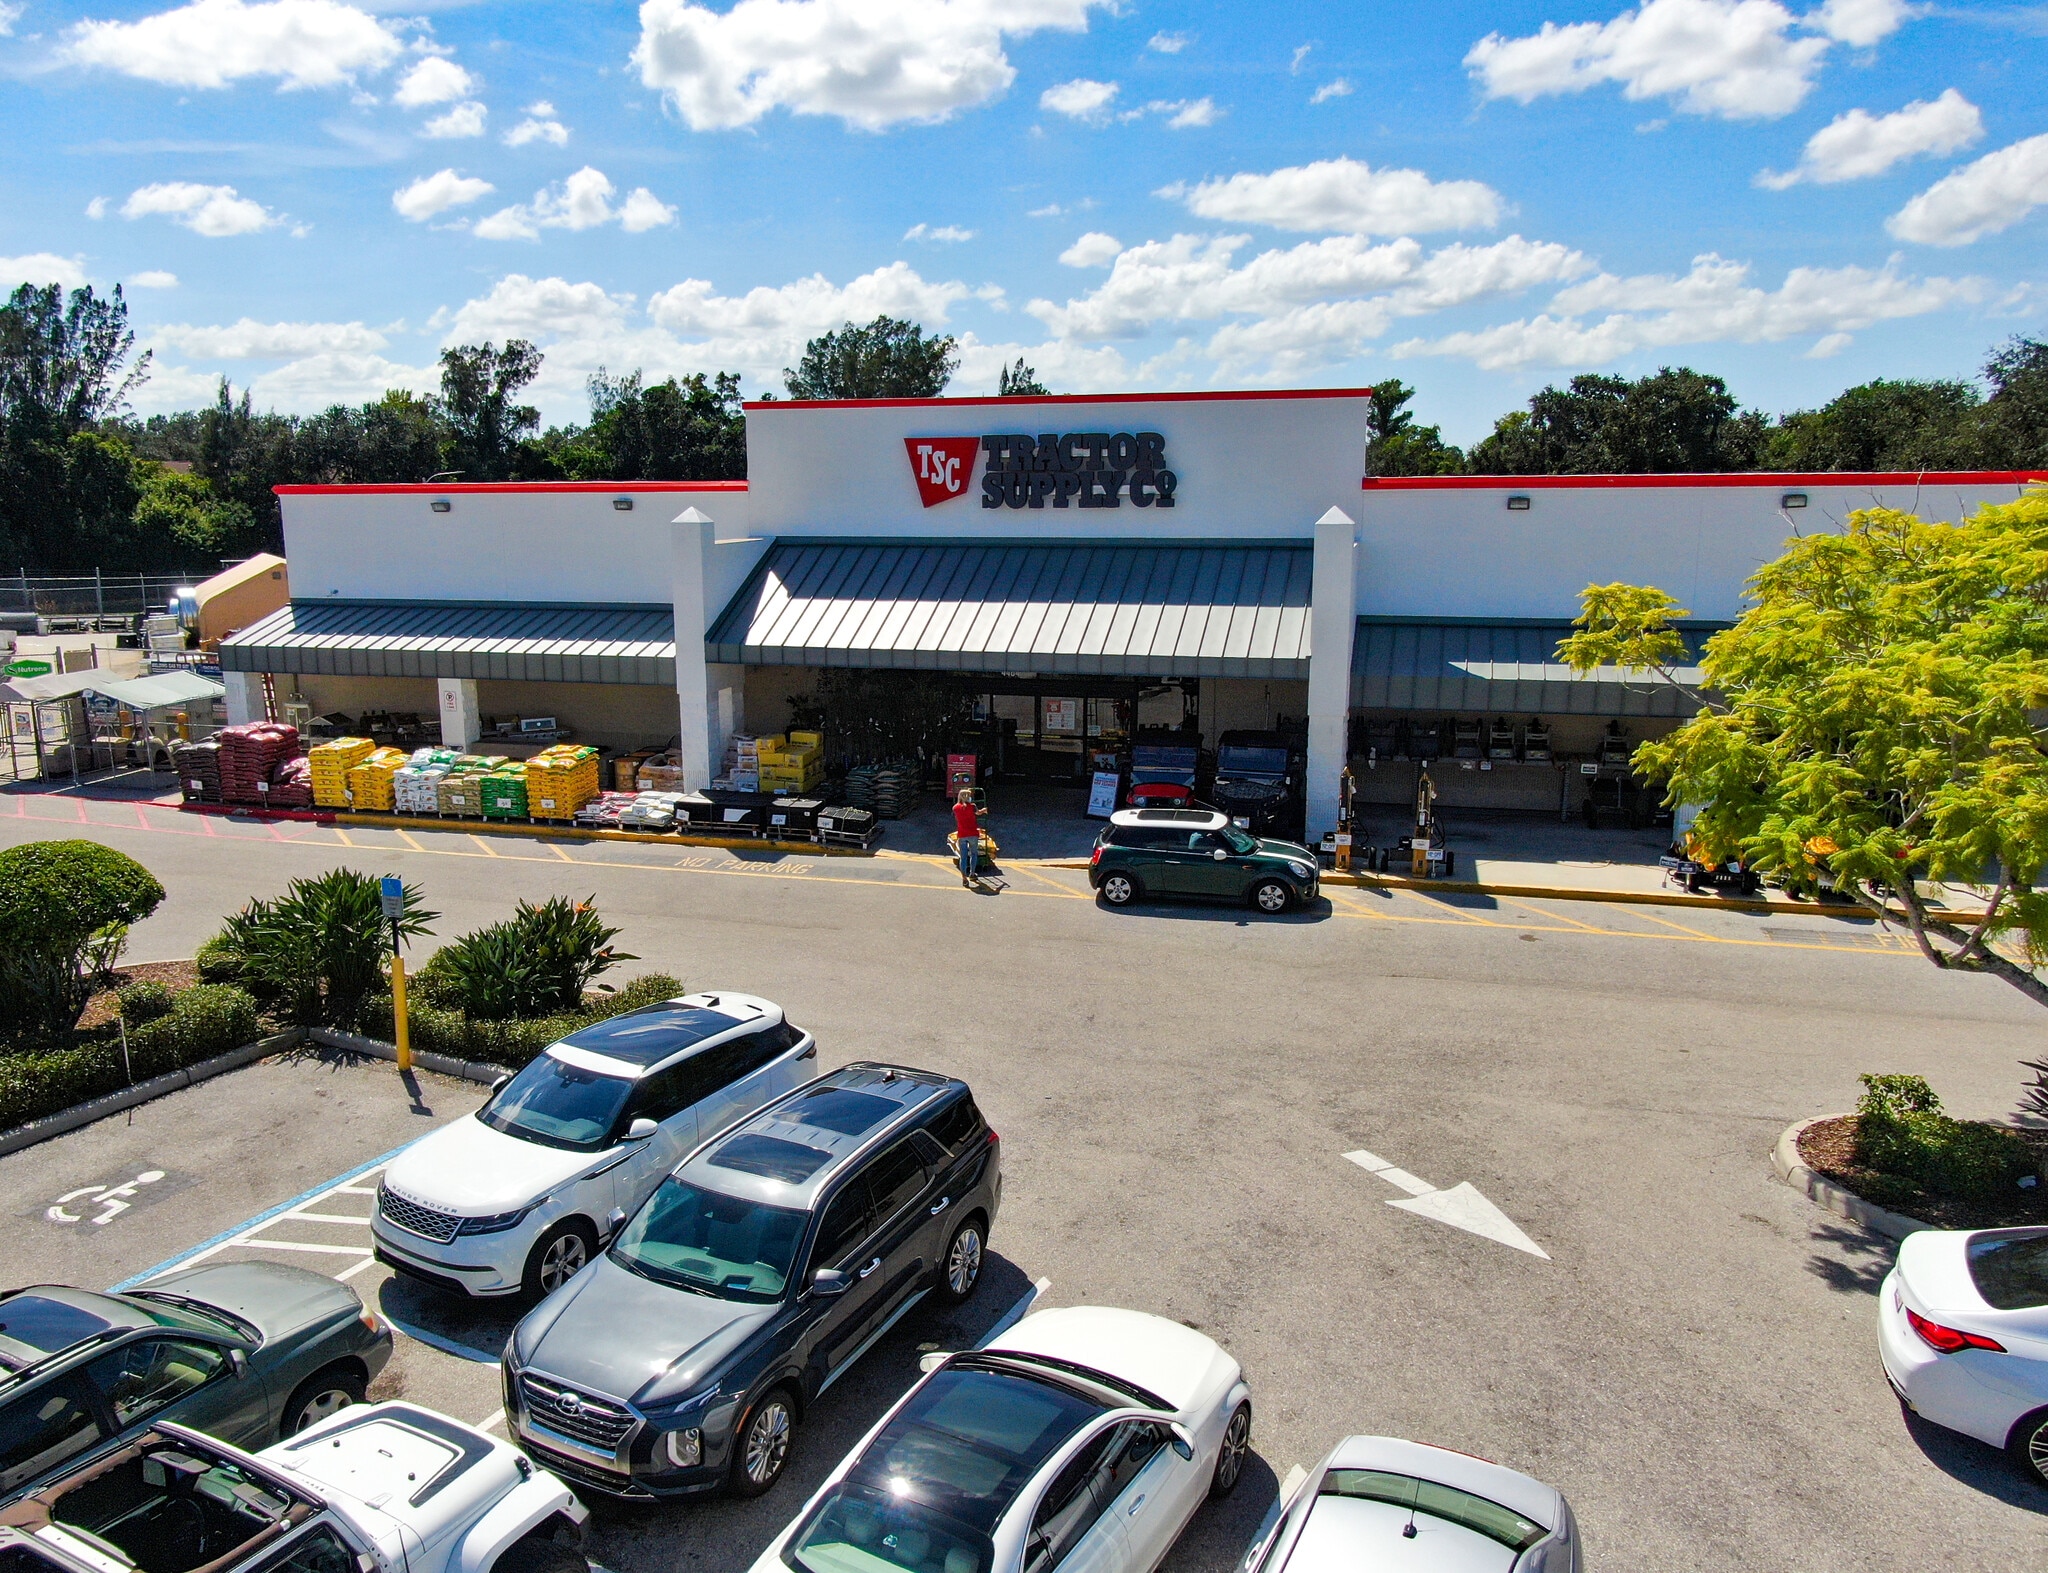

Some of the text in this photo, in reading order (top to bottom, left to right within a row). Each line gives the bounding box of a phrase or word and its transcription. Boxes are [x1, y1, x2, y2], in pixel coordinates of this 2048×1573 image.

[917, 445, 960, 492] TSC
[982, 432, 1166, 471] TRACTOR
[982, 470, 1126, 509] SUPPLY
[674, 857, 814, 873] NO PARKING
[423, 1200, 457, 1213] ROVER
